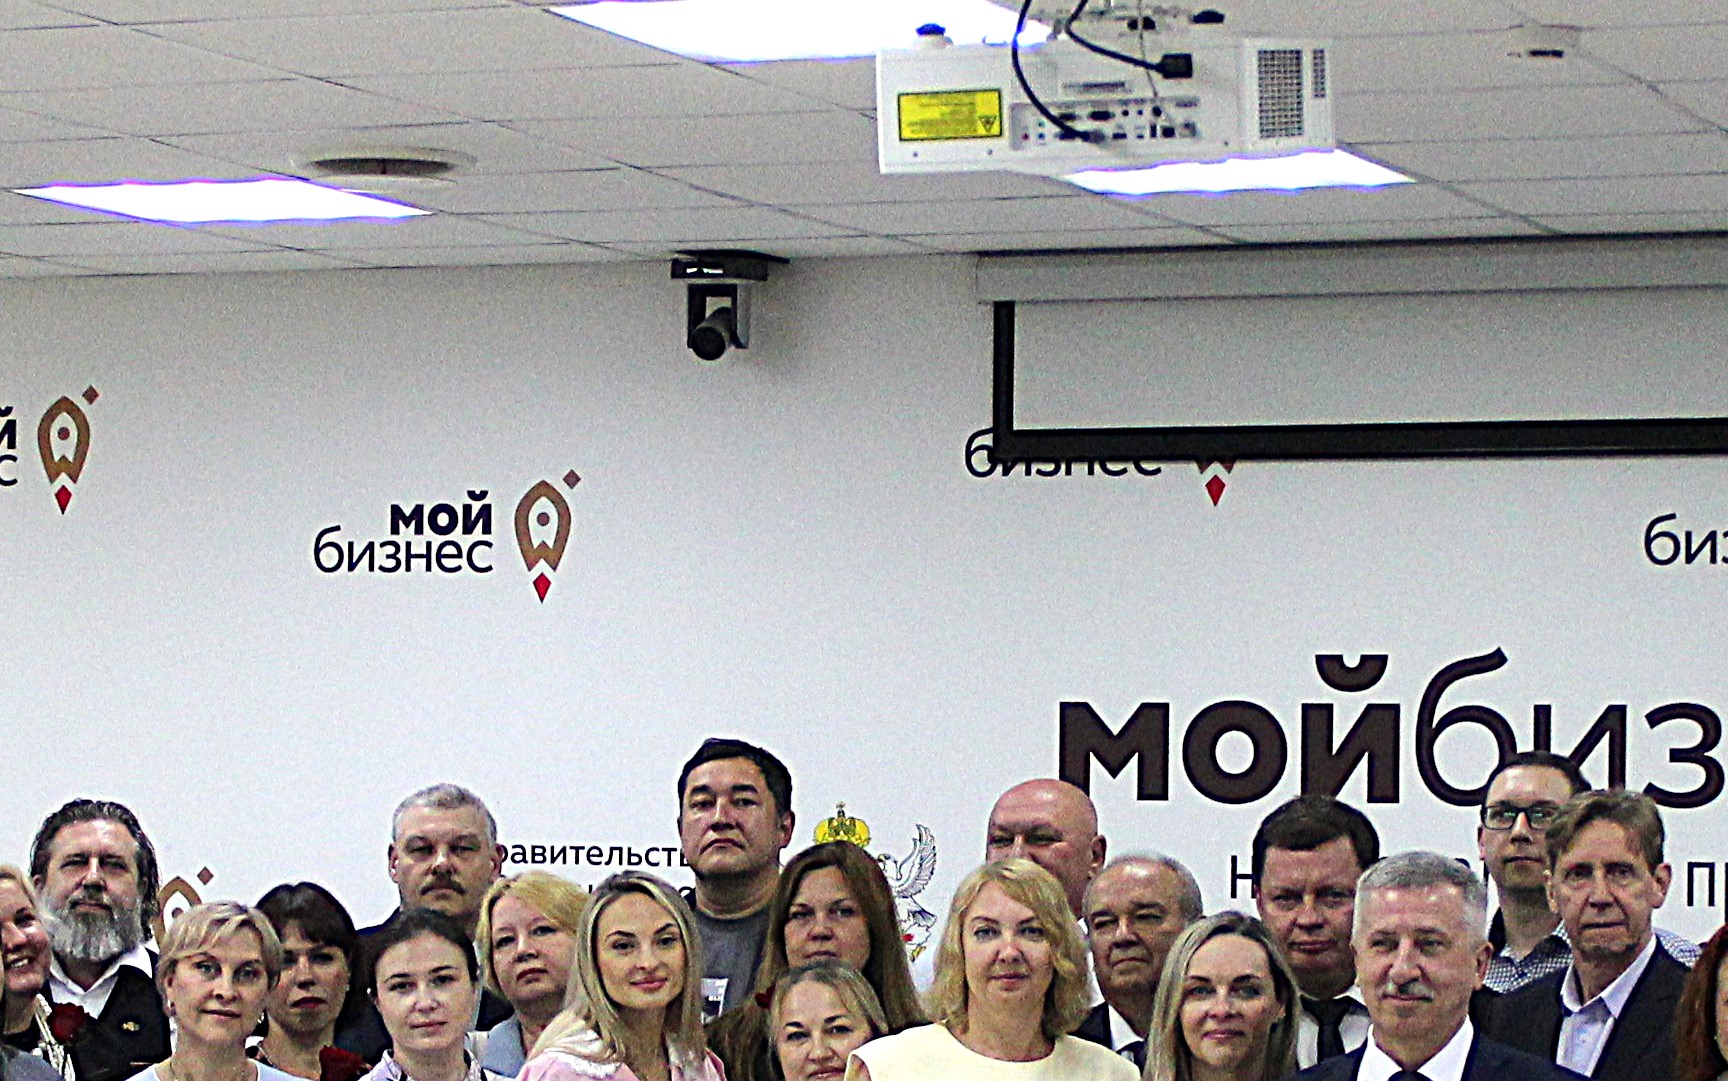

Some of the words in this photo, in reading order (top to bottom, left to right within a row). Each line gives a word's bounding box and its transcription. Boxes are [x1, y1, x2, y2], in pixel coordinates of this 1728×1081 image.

[390, 491, 492, 536] мой
[313, 525, 494, 574] бизнес
[501, 844, 691, 868] авительст
